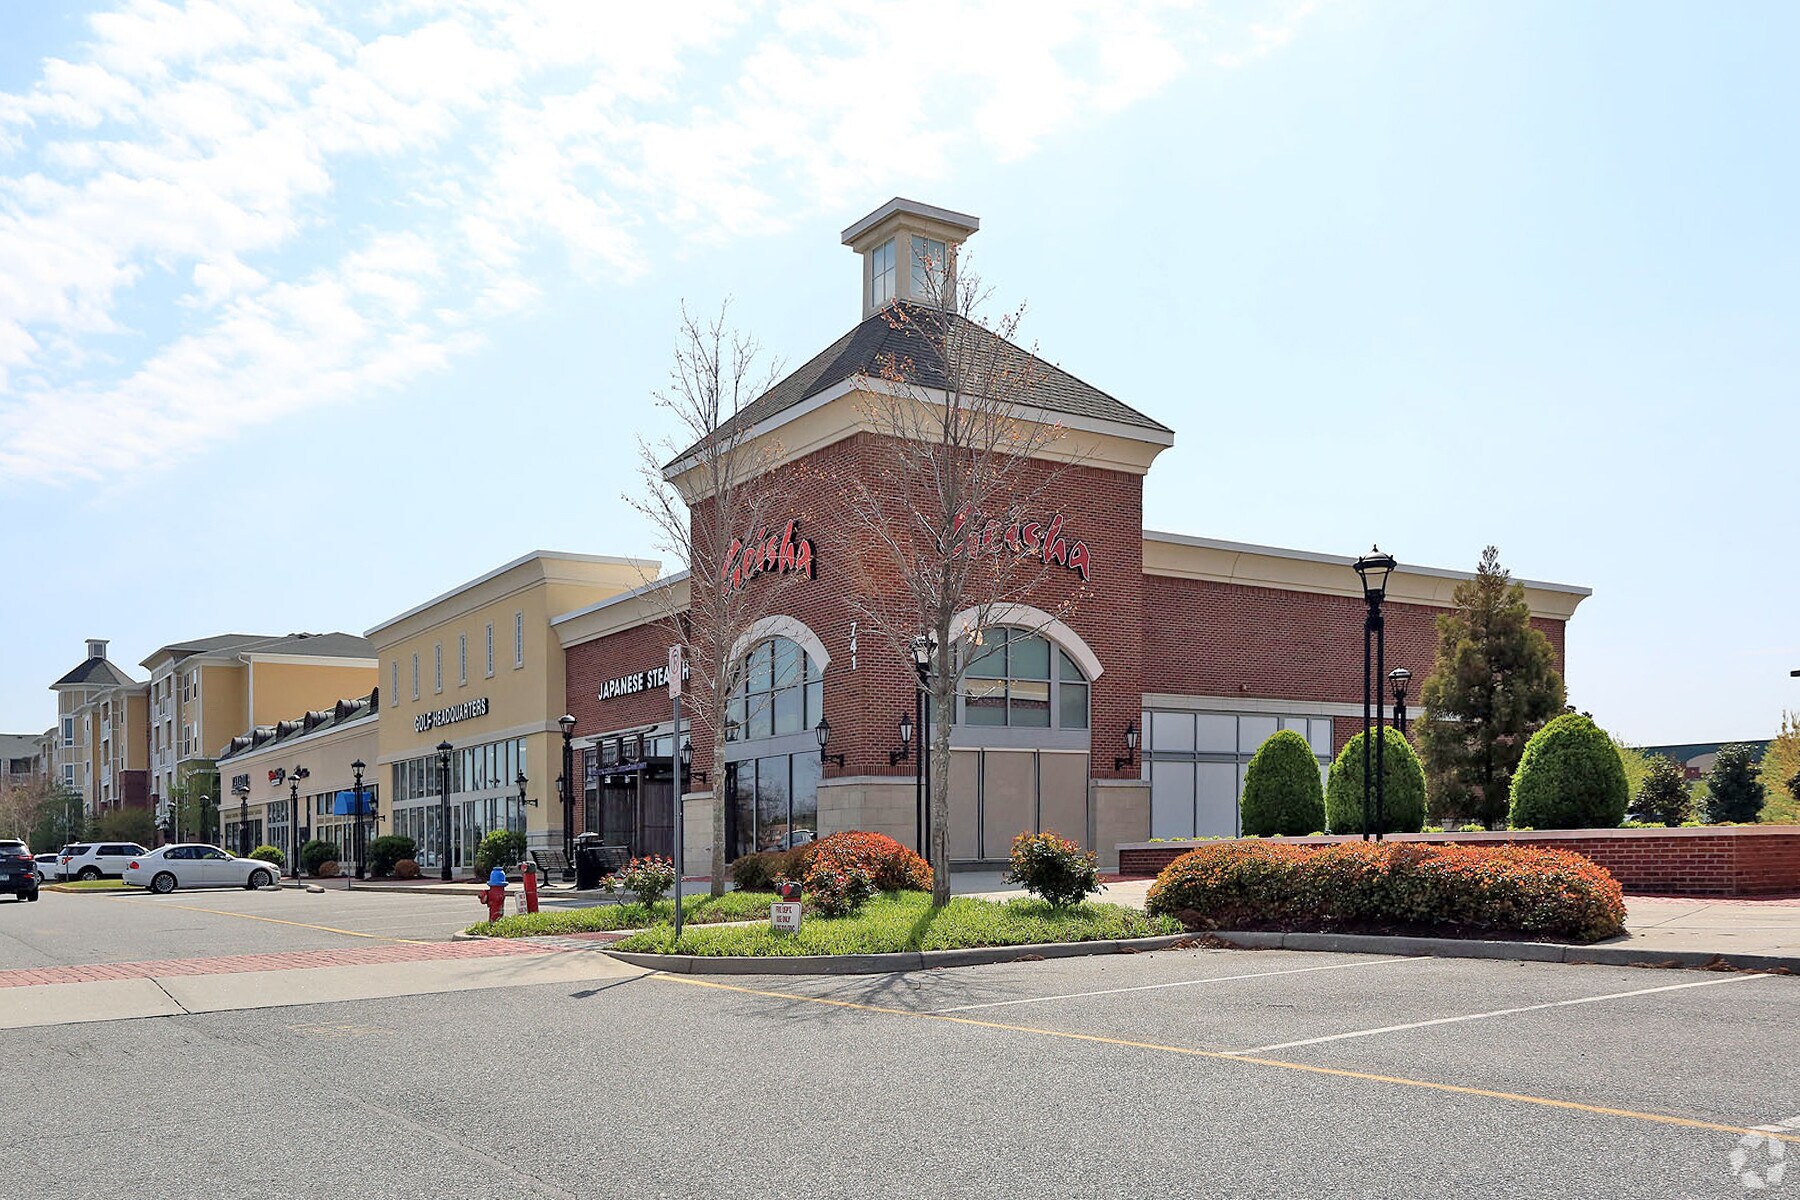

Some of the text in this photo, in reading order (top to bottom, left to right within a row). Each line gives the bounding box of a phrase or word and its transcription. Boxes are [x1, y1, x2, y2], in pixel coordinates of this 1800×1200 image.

[850, 621, 858, 670] 741
[598, 672, 645, 701] JAPANESE
[646, 660, 690, 690] STEAH
[414, 697, 487, 733] GOLF HEADQUARTERS
